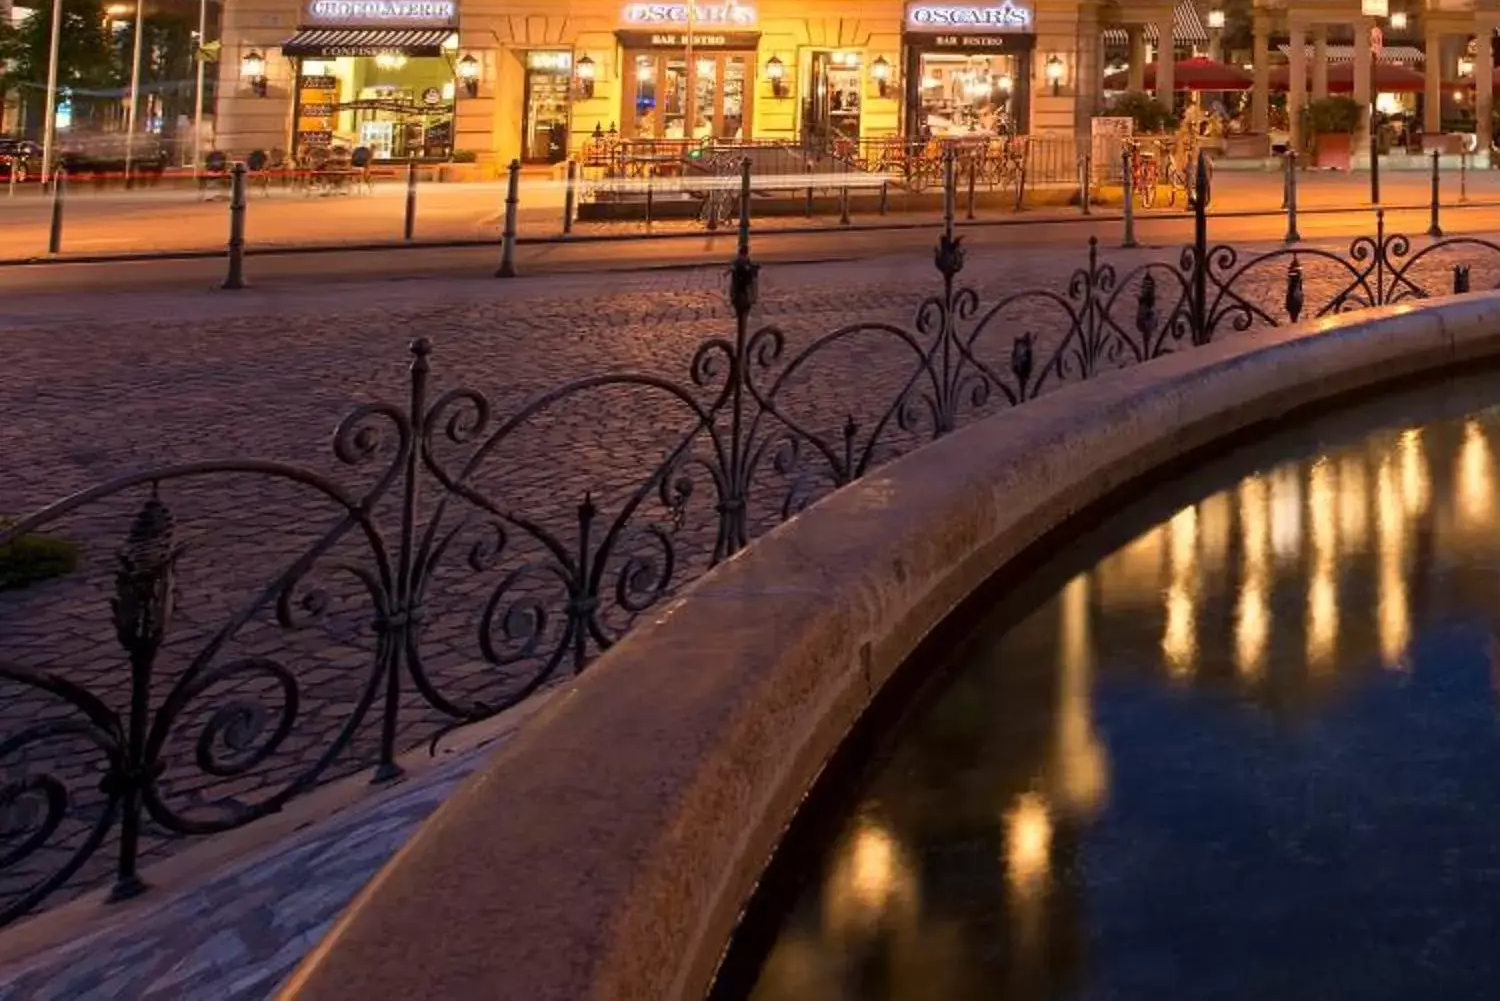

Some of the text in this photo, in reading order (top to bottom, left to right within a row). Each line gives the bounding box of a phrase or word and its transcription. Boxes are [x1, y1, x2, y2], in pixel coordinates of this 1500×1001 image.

[312, 0, 453, 18] CHOCOLATERIE
[913, 1, 1027, 24] OSCAR'S
[652, 35, 726, 46] BAR BSTRO
[935, 35, 959, 46] BAR
